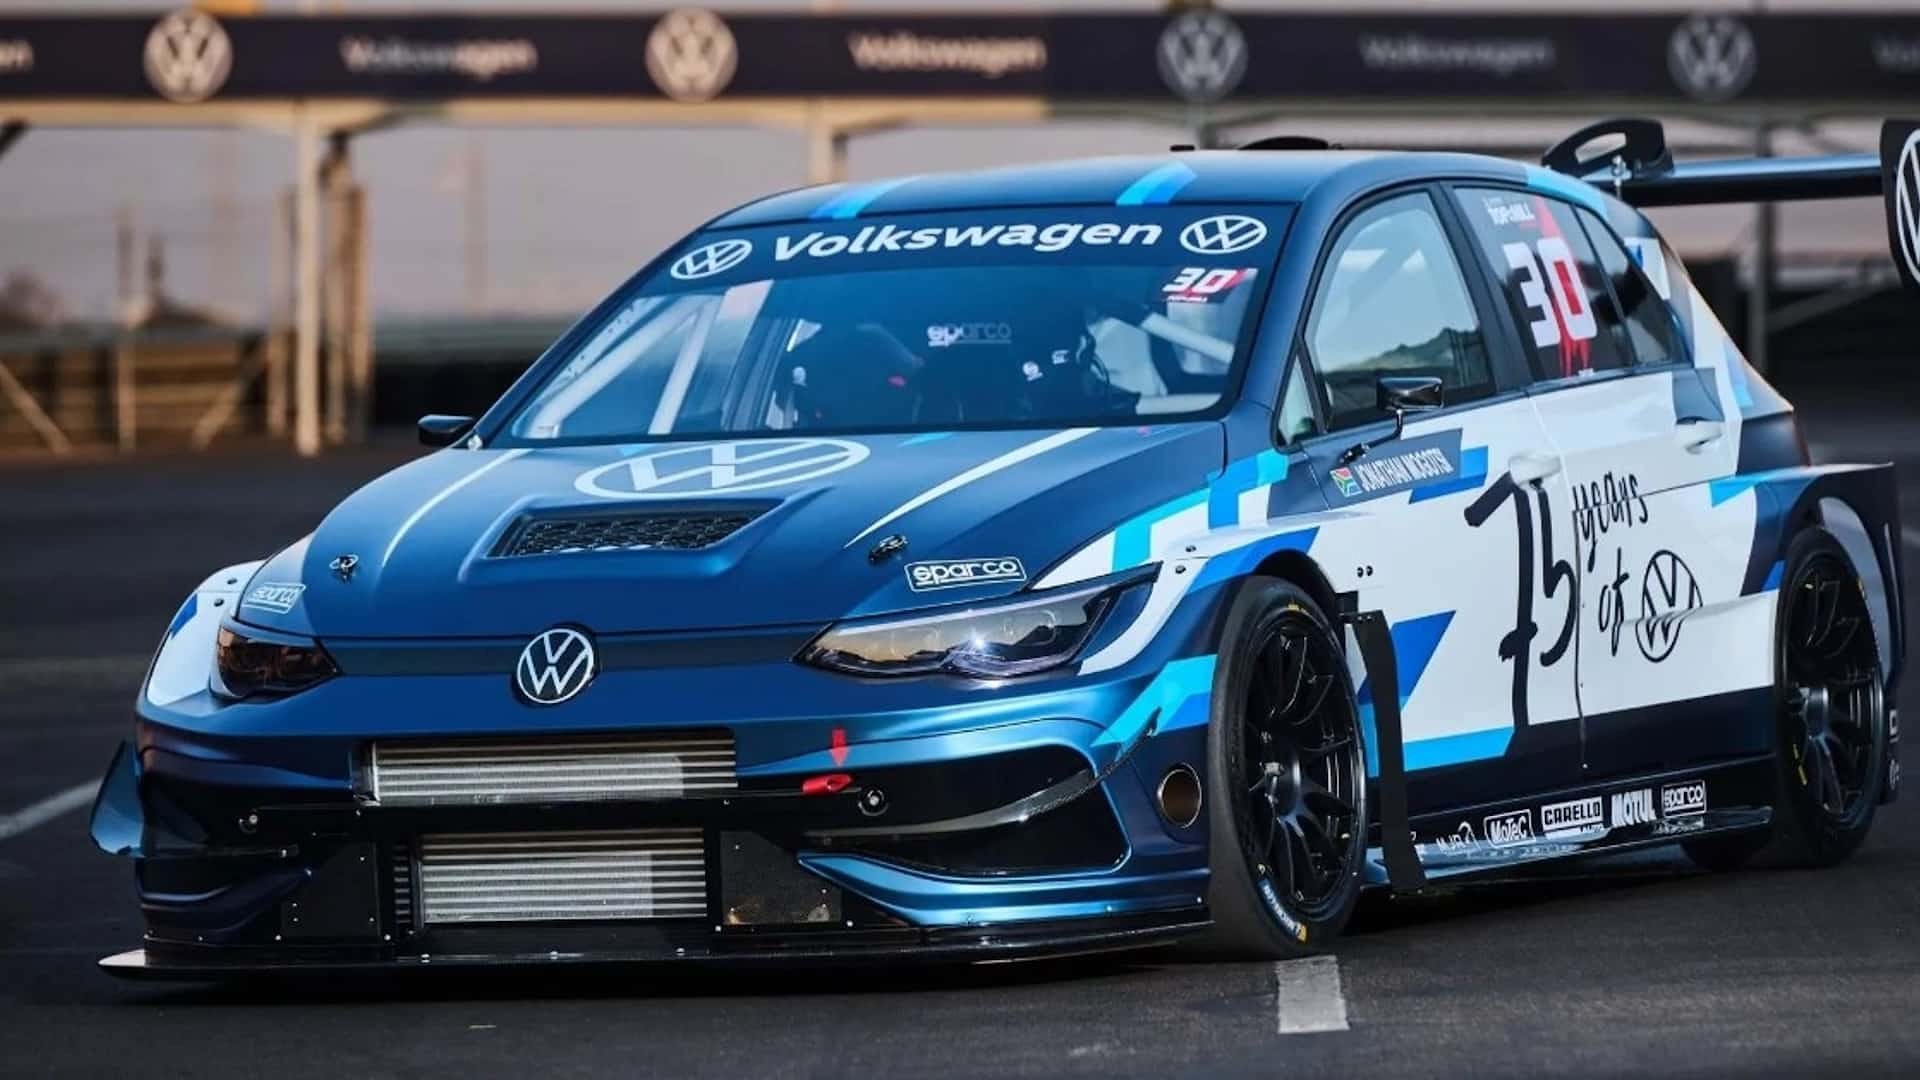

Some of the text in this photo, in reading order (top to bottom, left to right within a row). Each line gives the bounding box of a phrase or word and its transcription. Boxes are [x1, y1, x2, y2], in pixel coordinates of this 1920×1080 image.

[774, 222, 1162, 261] Volkswagen
[1162, 267, 1238, 293] 30
[1503, 238, 1597, 347] 30
[1573, 471, 1648, 573] years
[913, 561, 1020, 585] sparco
[1464, 471, 1577, 727] 75
[1599, 547, 1630, 657] of
[1543, 801, 1601, 826] CARELLO
[1611, 788, 1656, 828] MOTUL
[1664, 785, 1704, 812] sparco
